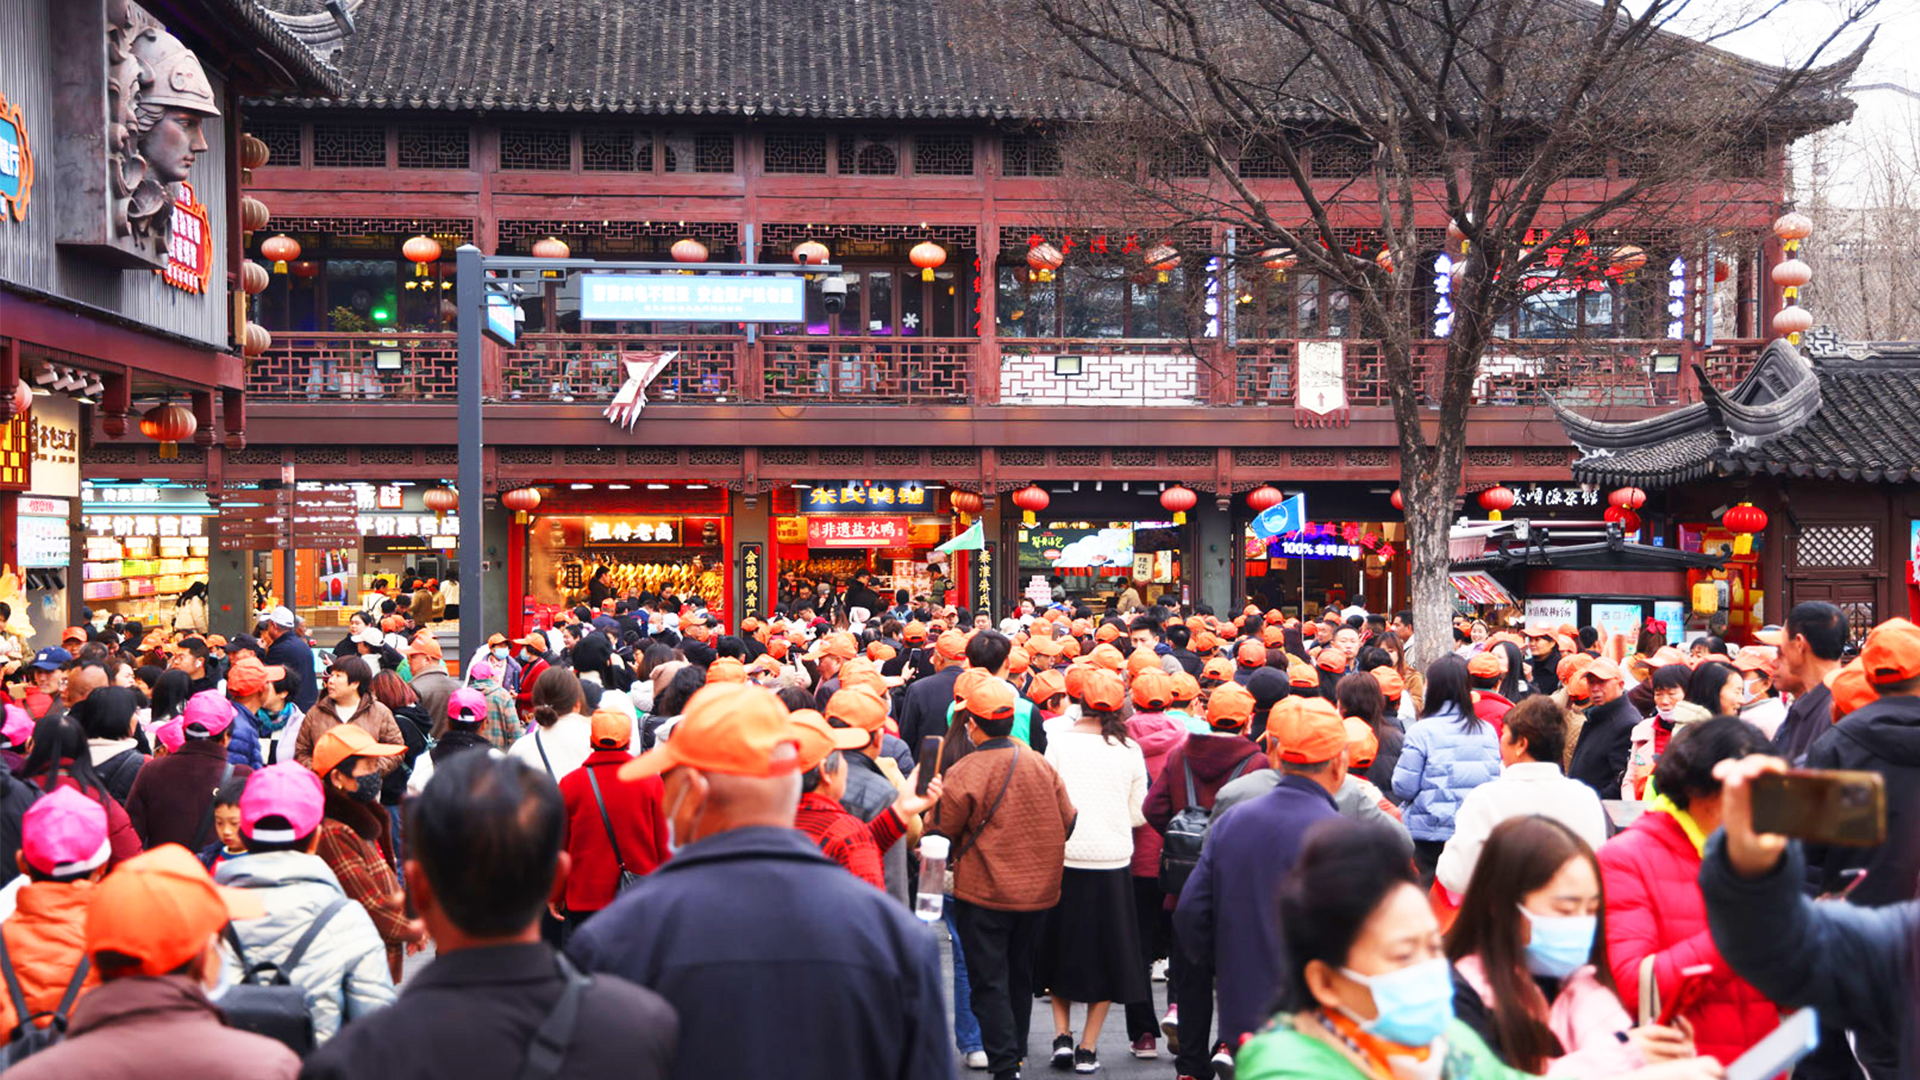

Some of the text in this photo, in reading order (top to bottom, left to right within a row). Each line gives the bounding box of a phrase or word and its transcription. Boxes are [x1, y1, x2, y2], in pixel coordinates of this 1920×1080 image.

[810, 486, 924, 505] 朱氏鸭铺
[589, 521, 673, 542] 祖传老卤
[821, 522, 896, 538] 非遗盐水鸭
[1281, 542, 1314, 555] 100%
[978, 550, 992, 611] 秦淮朱氏
